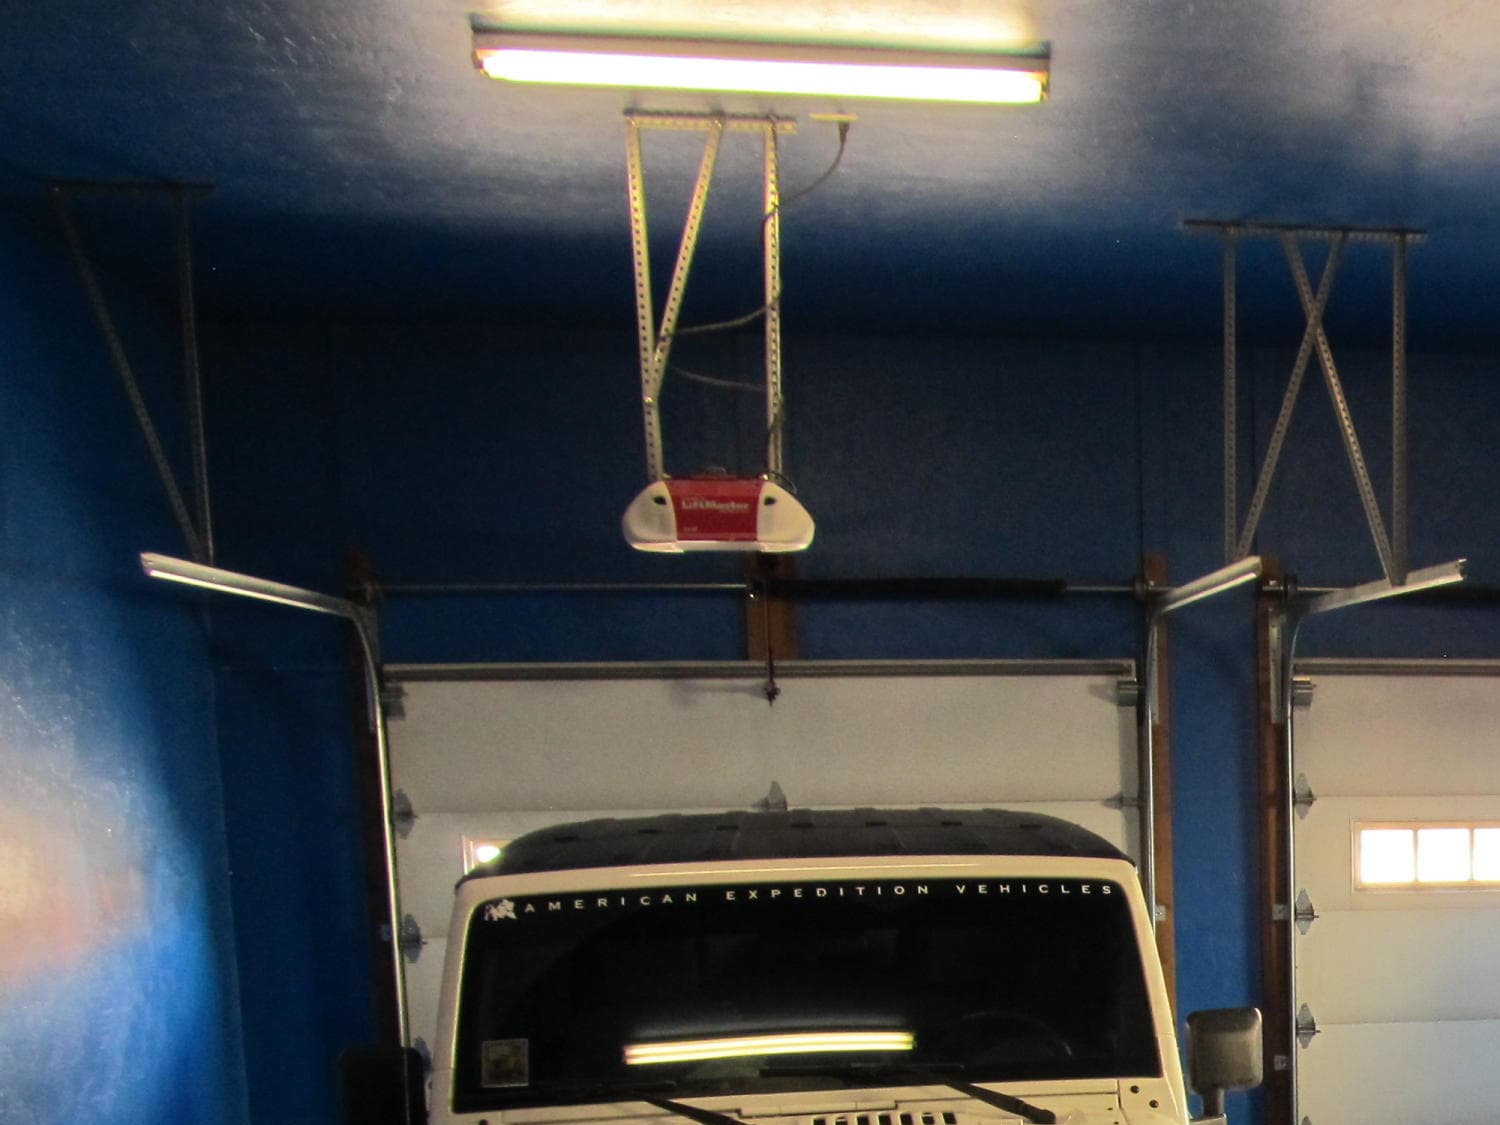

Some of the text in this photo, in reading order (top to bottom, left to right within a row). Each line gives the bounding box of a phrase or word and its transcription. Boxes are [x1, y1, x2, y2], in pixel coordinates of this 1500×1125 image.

[523, 884, 1112, 913] AMERICAN EXPEDITION VEHICLES
